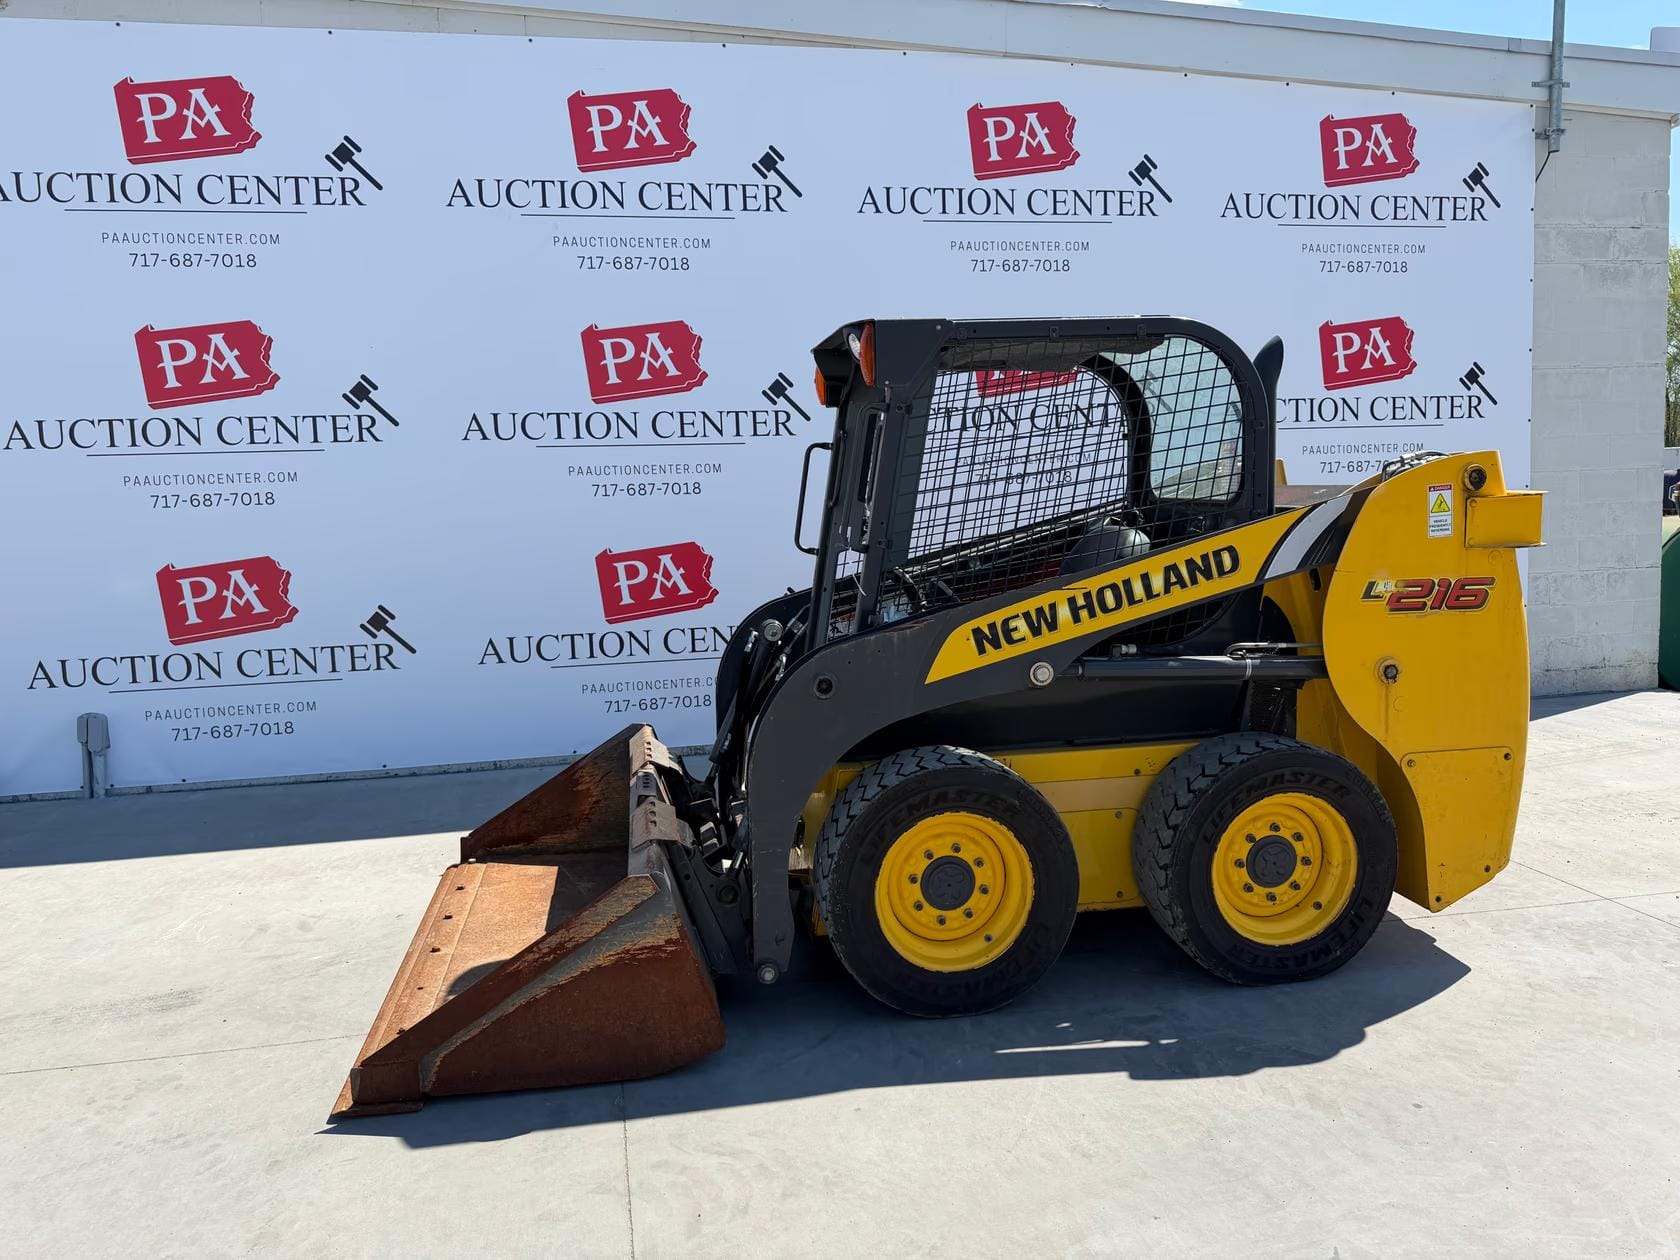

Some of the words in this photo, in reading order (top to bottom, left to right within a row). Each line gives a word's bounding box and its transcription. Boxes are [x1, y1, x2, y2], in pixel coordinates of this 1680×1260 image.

[135, 88, 230, 143] PA
[586, 101, 669, 152] PA
[983, 113, 1056, 161] PA
[1334, 124, 1398, 169] PA
[197, 174, 369, 206] CENTER
[445, 178, 625, 210] AUCTION
[638, 181, 789, 212] CENTER
[857, 185, 1017, 215] AUCTION
[1027, 189, 1160, 216] CENTER
[1219, 192, 1362, 220] AUCTION
[1370, 195, 1490, 221] CENTER
[102, 232, 280, 246] PAAUCTIONCENTER.COM
[553, 236, 710, 248] PAAUCTIONCENTER.COM
[951, 240, 1089, 252] PAAUCTIONCENTER.COM
[1302, 243, 1425, 255] PAAUCTIONCENTER.COM
[129, 253, 256, 268] 717-687-7018
[577, 256, 689, 272] 717-687-7018
[971, 258, 1070, 272] 717-687-7018
[1320, 260, 1408, 273] 717-687-7018
[155, 333, 250, 388] PA
[599, 333, 681, 384] PA
[1333, 327, 1395, 373] PA
[1370, 395, 1486, 421] CENTER
[2, 417, 203, 450] AUCTION
[217, 414, 384, 446] CENTER
[461, 412, 640, 441] AUCTION
[651, 409, 797, 439] CENTER
[124, 472, 297, 487] PAAUCTIONCENTER.COM
[568, 463, 721, 476] PAAUCTIONCENTER.COM
[1320, 460, 1388, 475] 717-687-7
[150, 492, 275, 508] 717-687-7018
[592, 482, 703, 497] 717-687-7018
[614, 554, 692, 604] PA
[176, 570, 268, 624] PA
[971, 601, 1059, 656] NEW
[1068, 545, 1240, 624] HOLLAND
[478, 632, 653, 665] AUCTION
[663, 626, 735, 656] CEN
[27, 652, 223, 690] AUCTION
[237, 643, 401, 677] CENTER
[582, 677, 715, 695] PAAUCTIONCENTER.C
[145, 701, 316, 722] PAAUCTIONCENTER.COM
[605, 694, 711, 713] 717-687-7018
[171, 721, 294, 741] 717-687-7018
